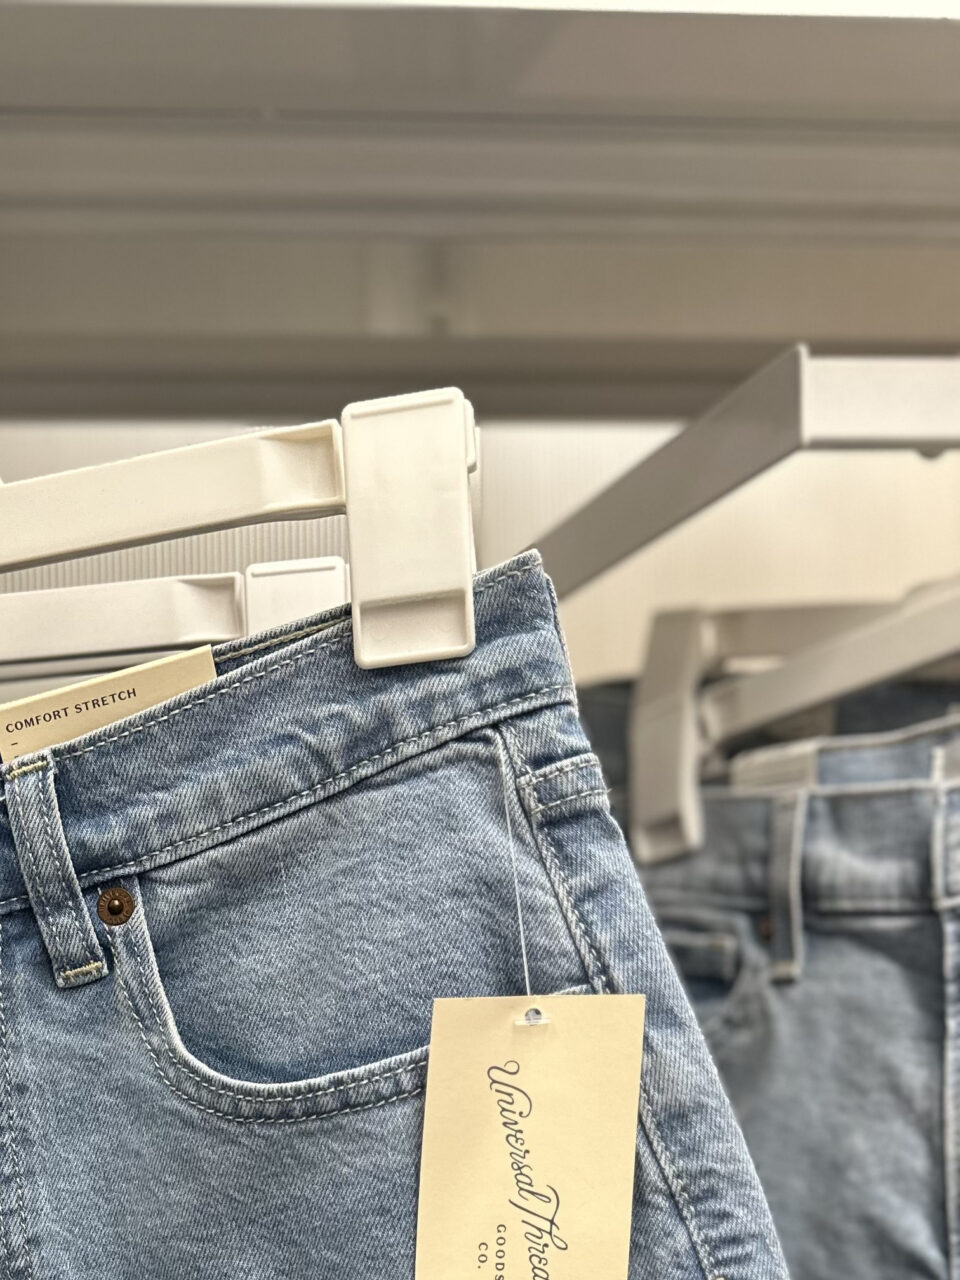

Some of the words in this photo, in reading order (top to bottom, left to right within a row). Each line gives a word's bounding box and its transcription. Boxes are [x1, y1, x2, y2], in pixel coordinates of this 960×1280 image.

[5, 707, 69, 733] COMFORT
[74, 688, 137, 714] STRETCH
[487, 1060, 552, 1204] Universal
[477, 1242, 489, 1269] CO.
